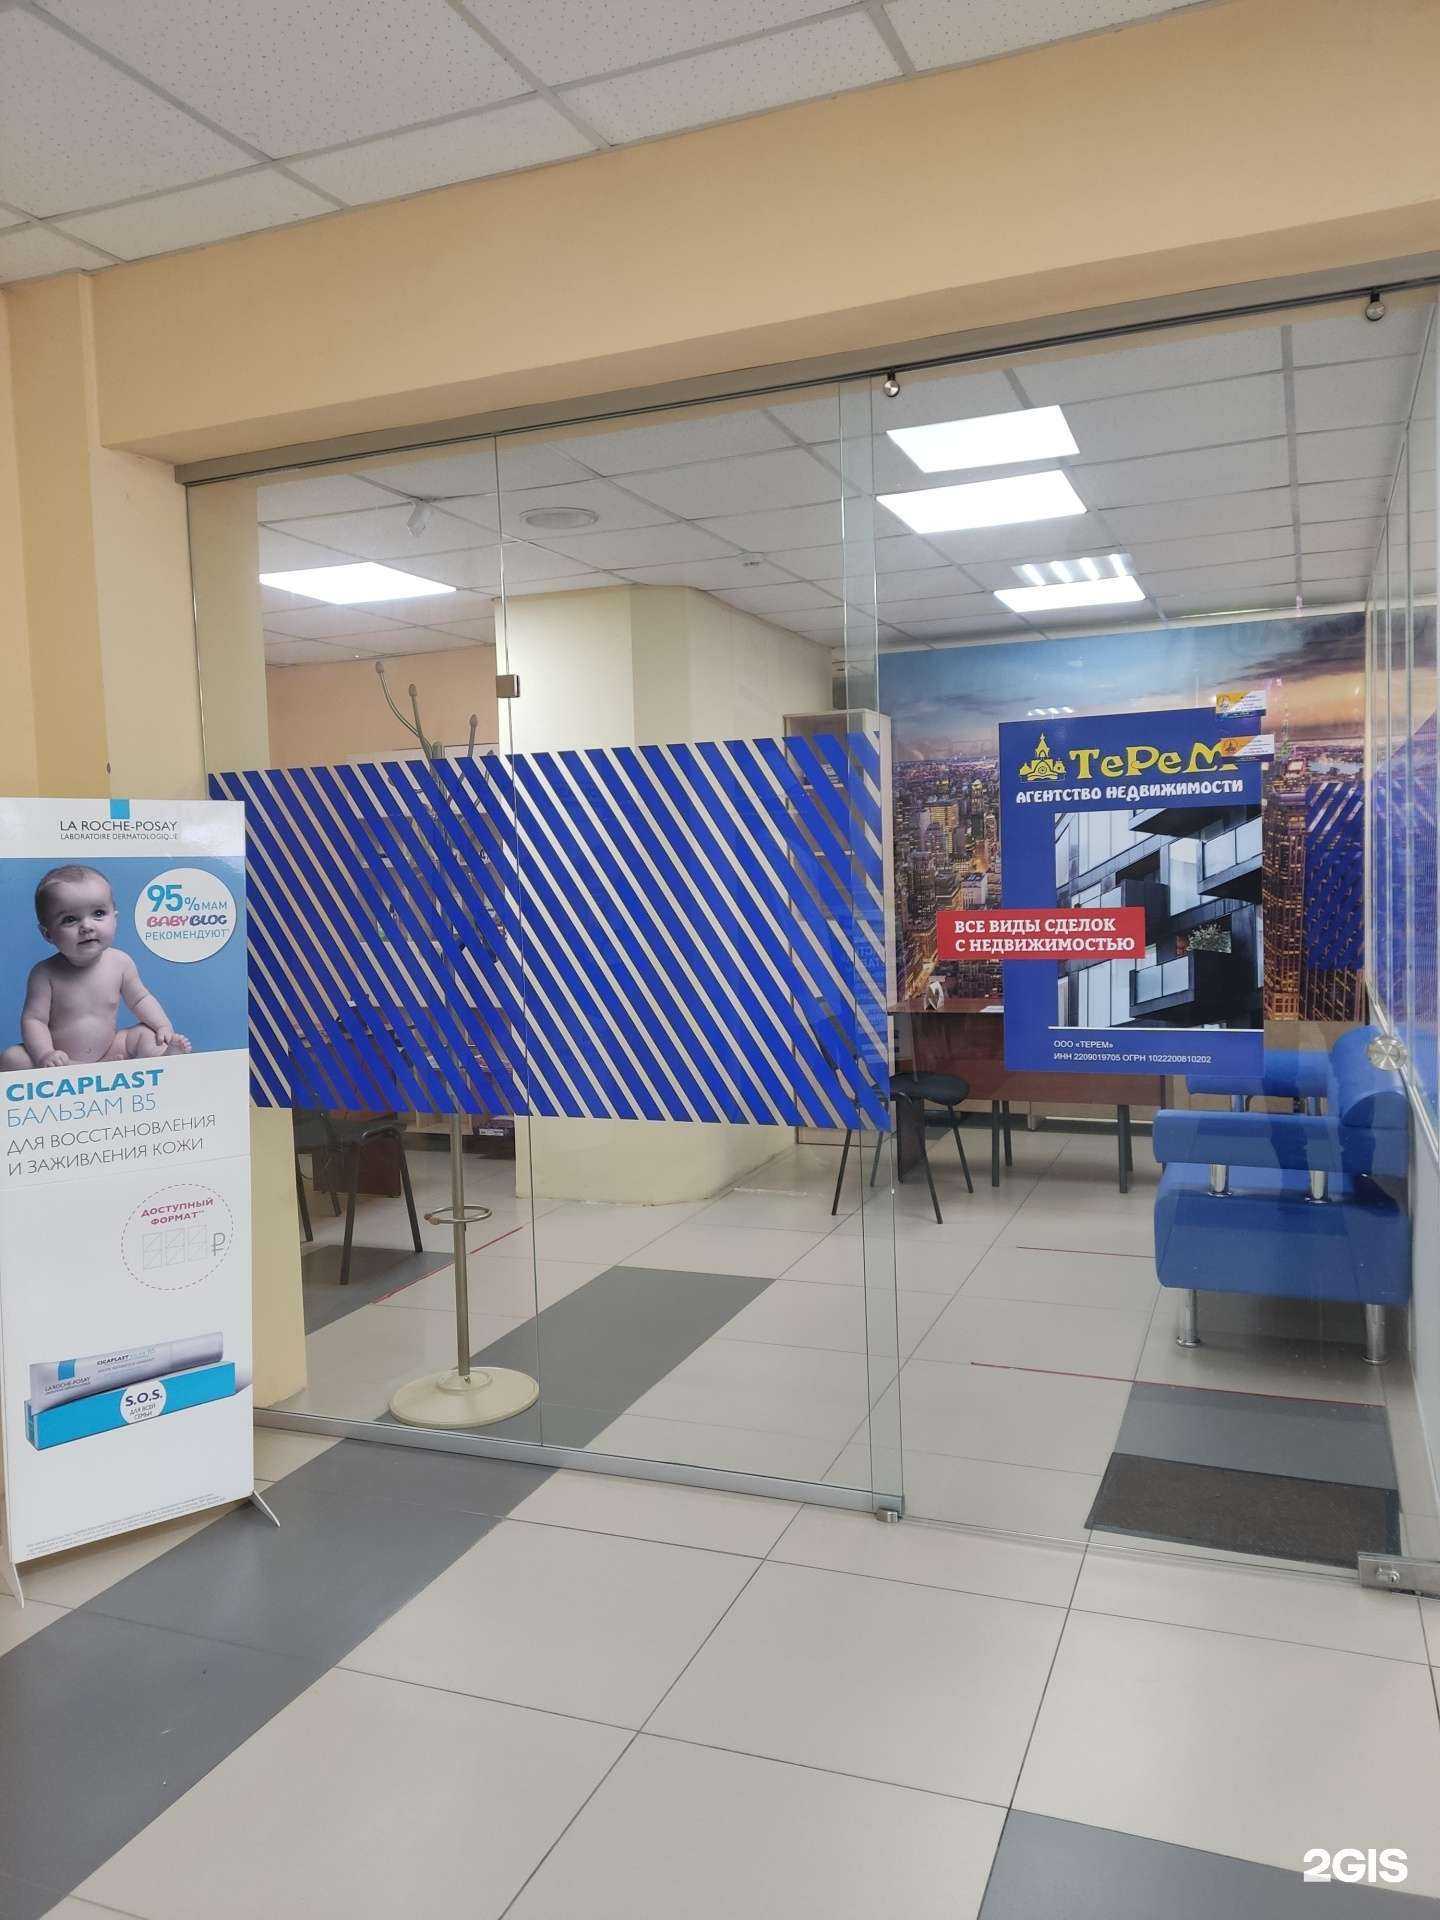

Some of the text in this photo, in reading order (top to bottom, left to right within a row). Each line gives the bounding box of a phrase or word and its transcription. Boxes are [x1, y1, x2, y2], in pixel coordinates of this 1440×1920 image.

[1016, 779, 1244, 804] АГЕНТСТВО НЕДВИЖИМОСТИ
[59, 819, 178, 832] LA ROCHE-POSAY
[201, 901, 228, 911] МАМ
[954, 918, 1117, 935] ВСЕ ВИДЫ СДЕЛОК
[955, 937, 1135, 954] С НЕДВИЖИМОСТЬЮ
[1053, 1040, 1114, 1049] ООО «ТЕРЕМ»
[1122, 1054, 1146, 1062] ОГРН
[6, 1068, 164, 1101] CICAPLAST
[7, 1097, 123, 1128] БАЛЬЗАМ
[7, 1114, 216, 1156] ДЛЯ ВОССТАНОВЛЕНИЯ
[8, 1137, 204, 1176] И ЗАЖИВЛЕНИЯ КОЖИ
[140, 1196, 214, 1218] ДОСТУПНЫЙ
[125, 1389, 163, 1406] S.O.S.
